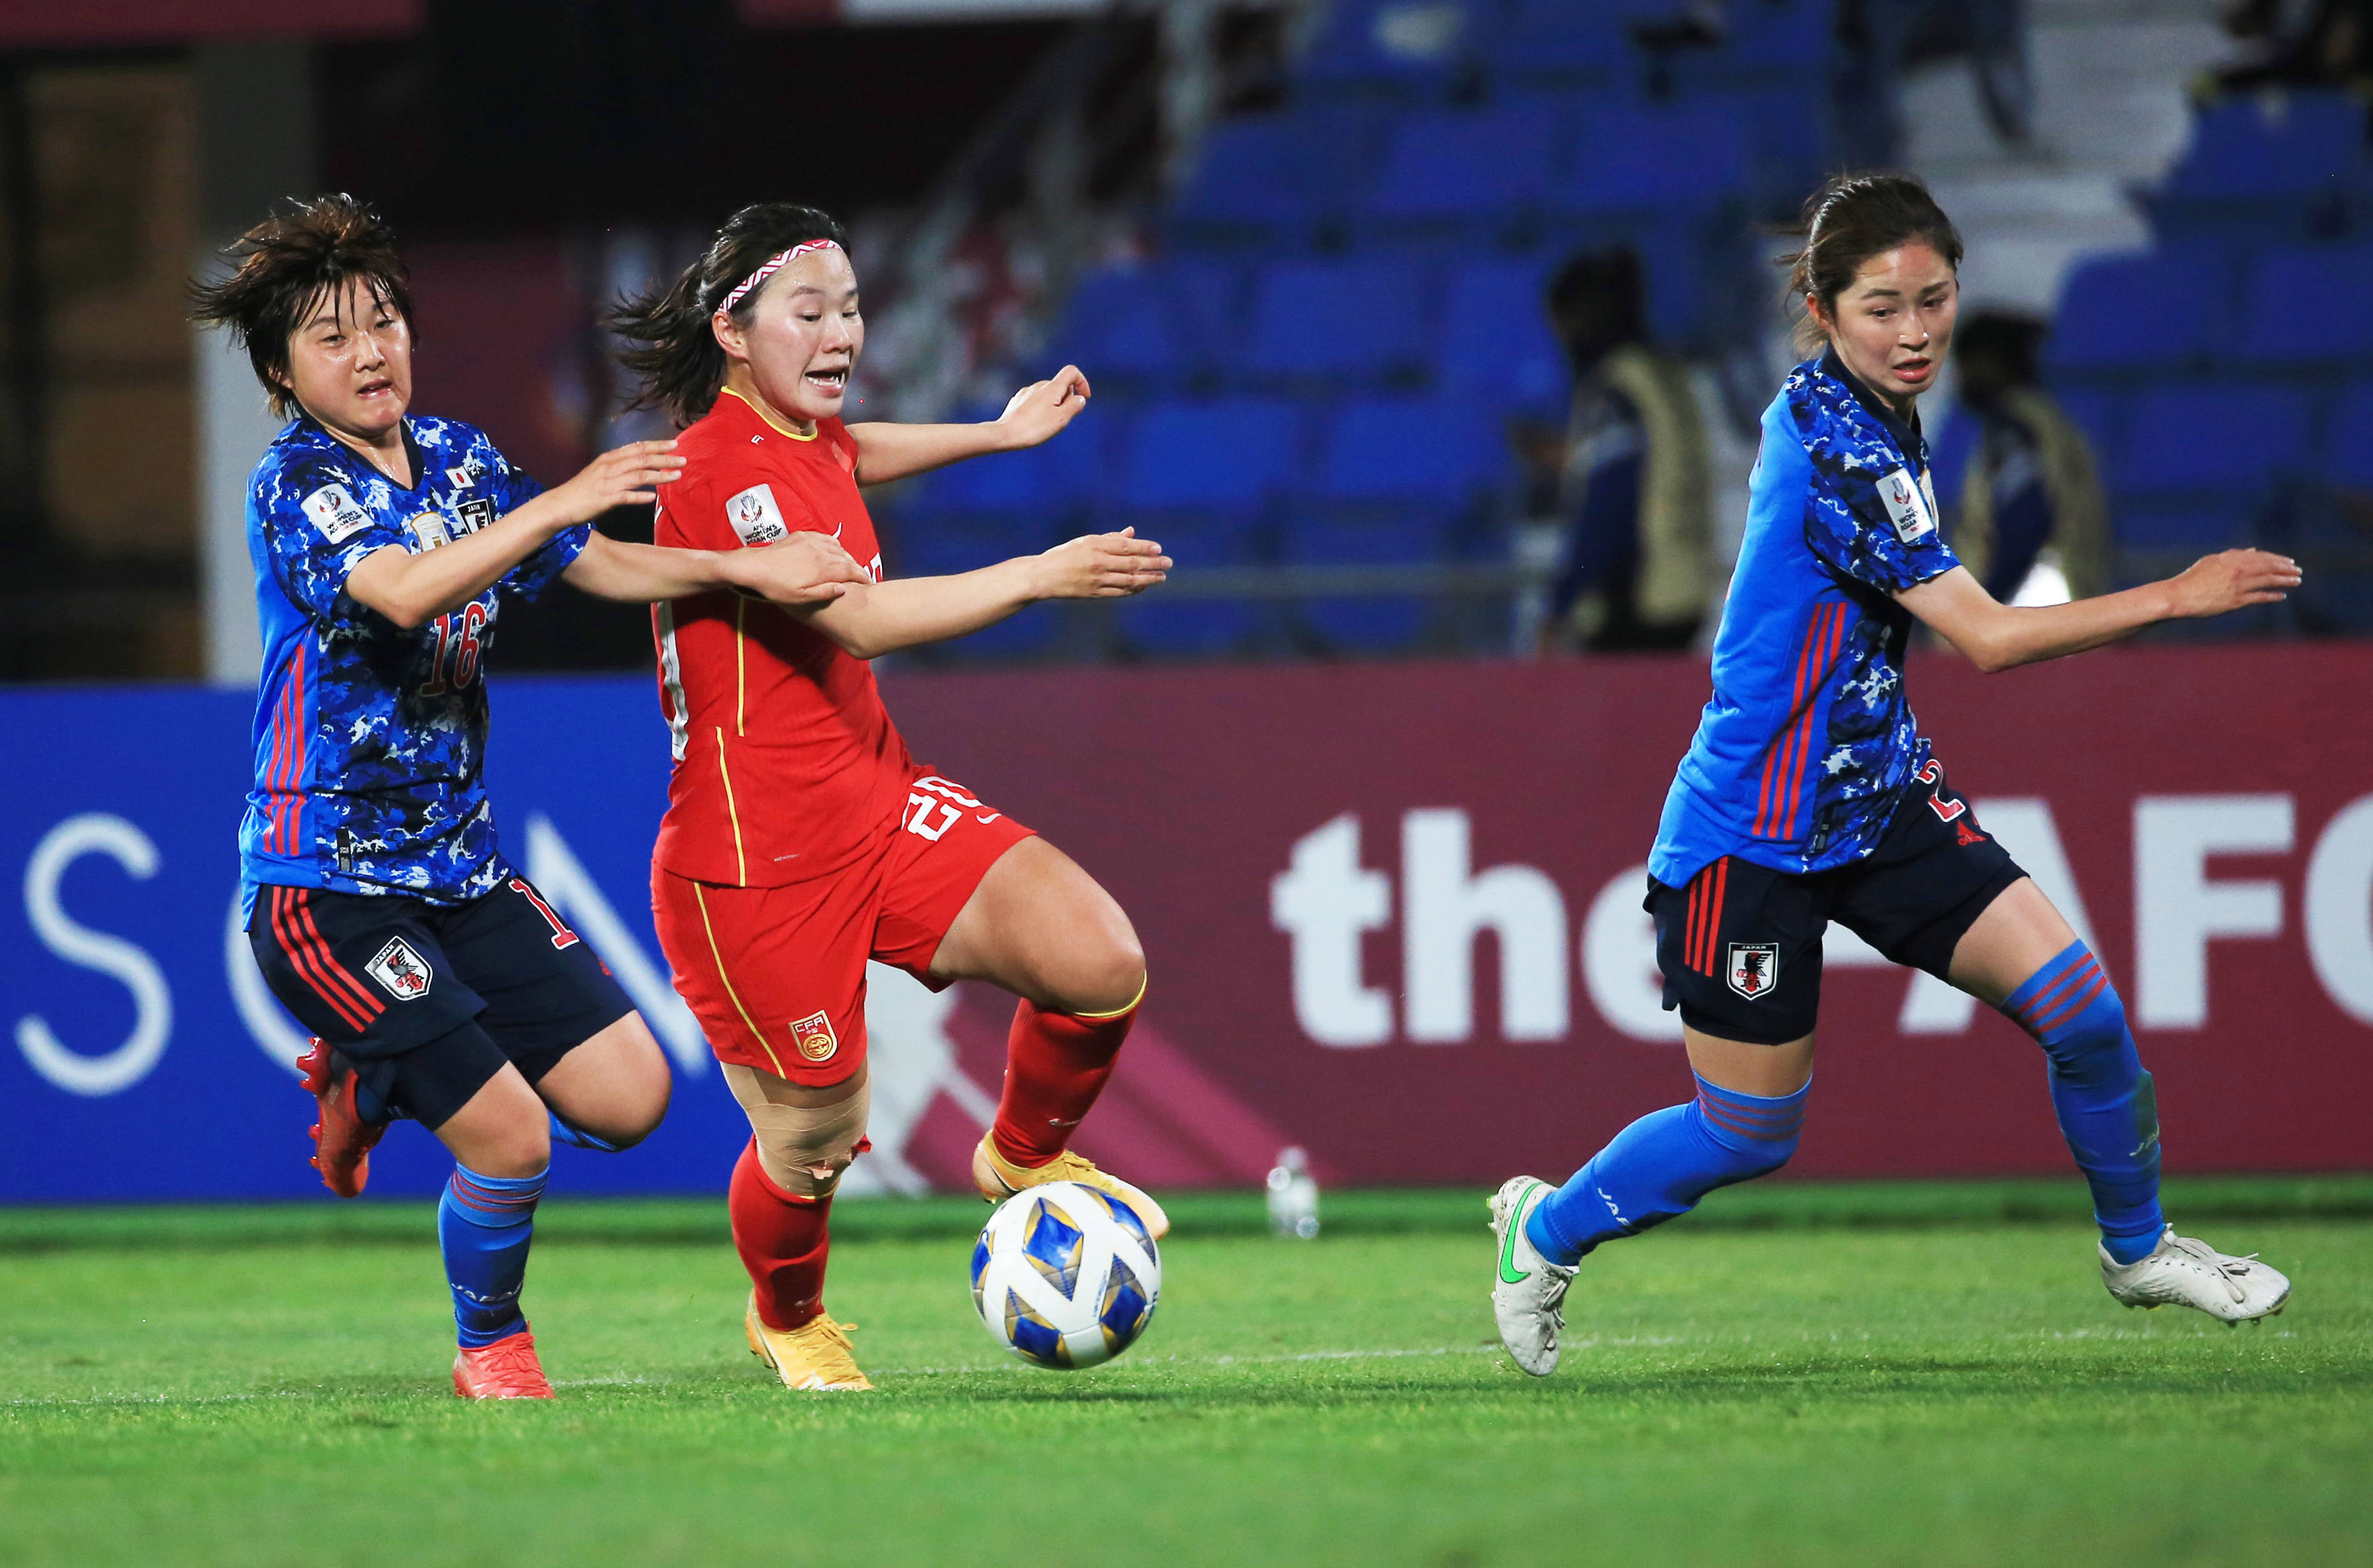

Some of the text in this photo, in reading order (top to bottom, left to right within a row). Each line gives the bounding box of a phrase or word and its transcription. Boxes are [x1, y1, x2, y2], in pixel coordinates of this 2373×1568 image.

[421, 601, 485, 697] 16
[1916, 758, 1966, 823] 2
[375, 944, 395, 964] JAPAN
[795, 1016, 824, 1033] CFA
